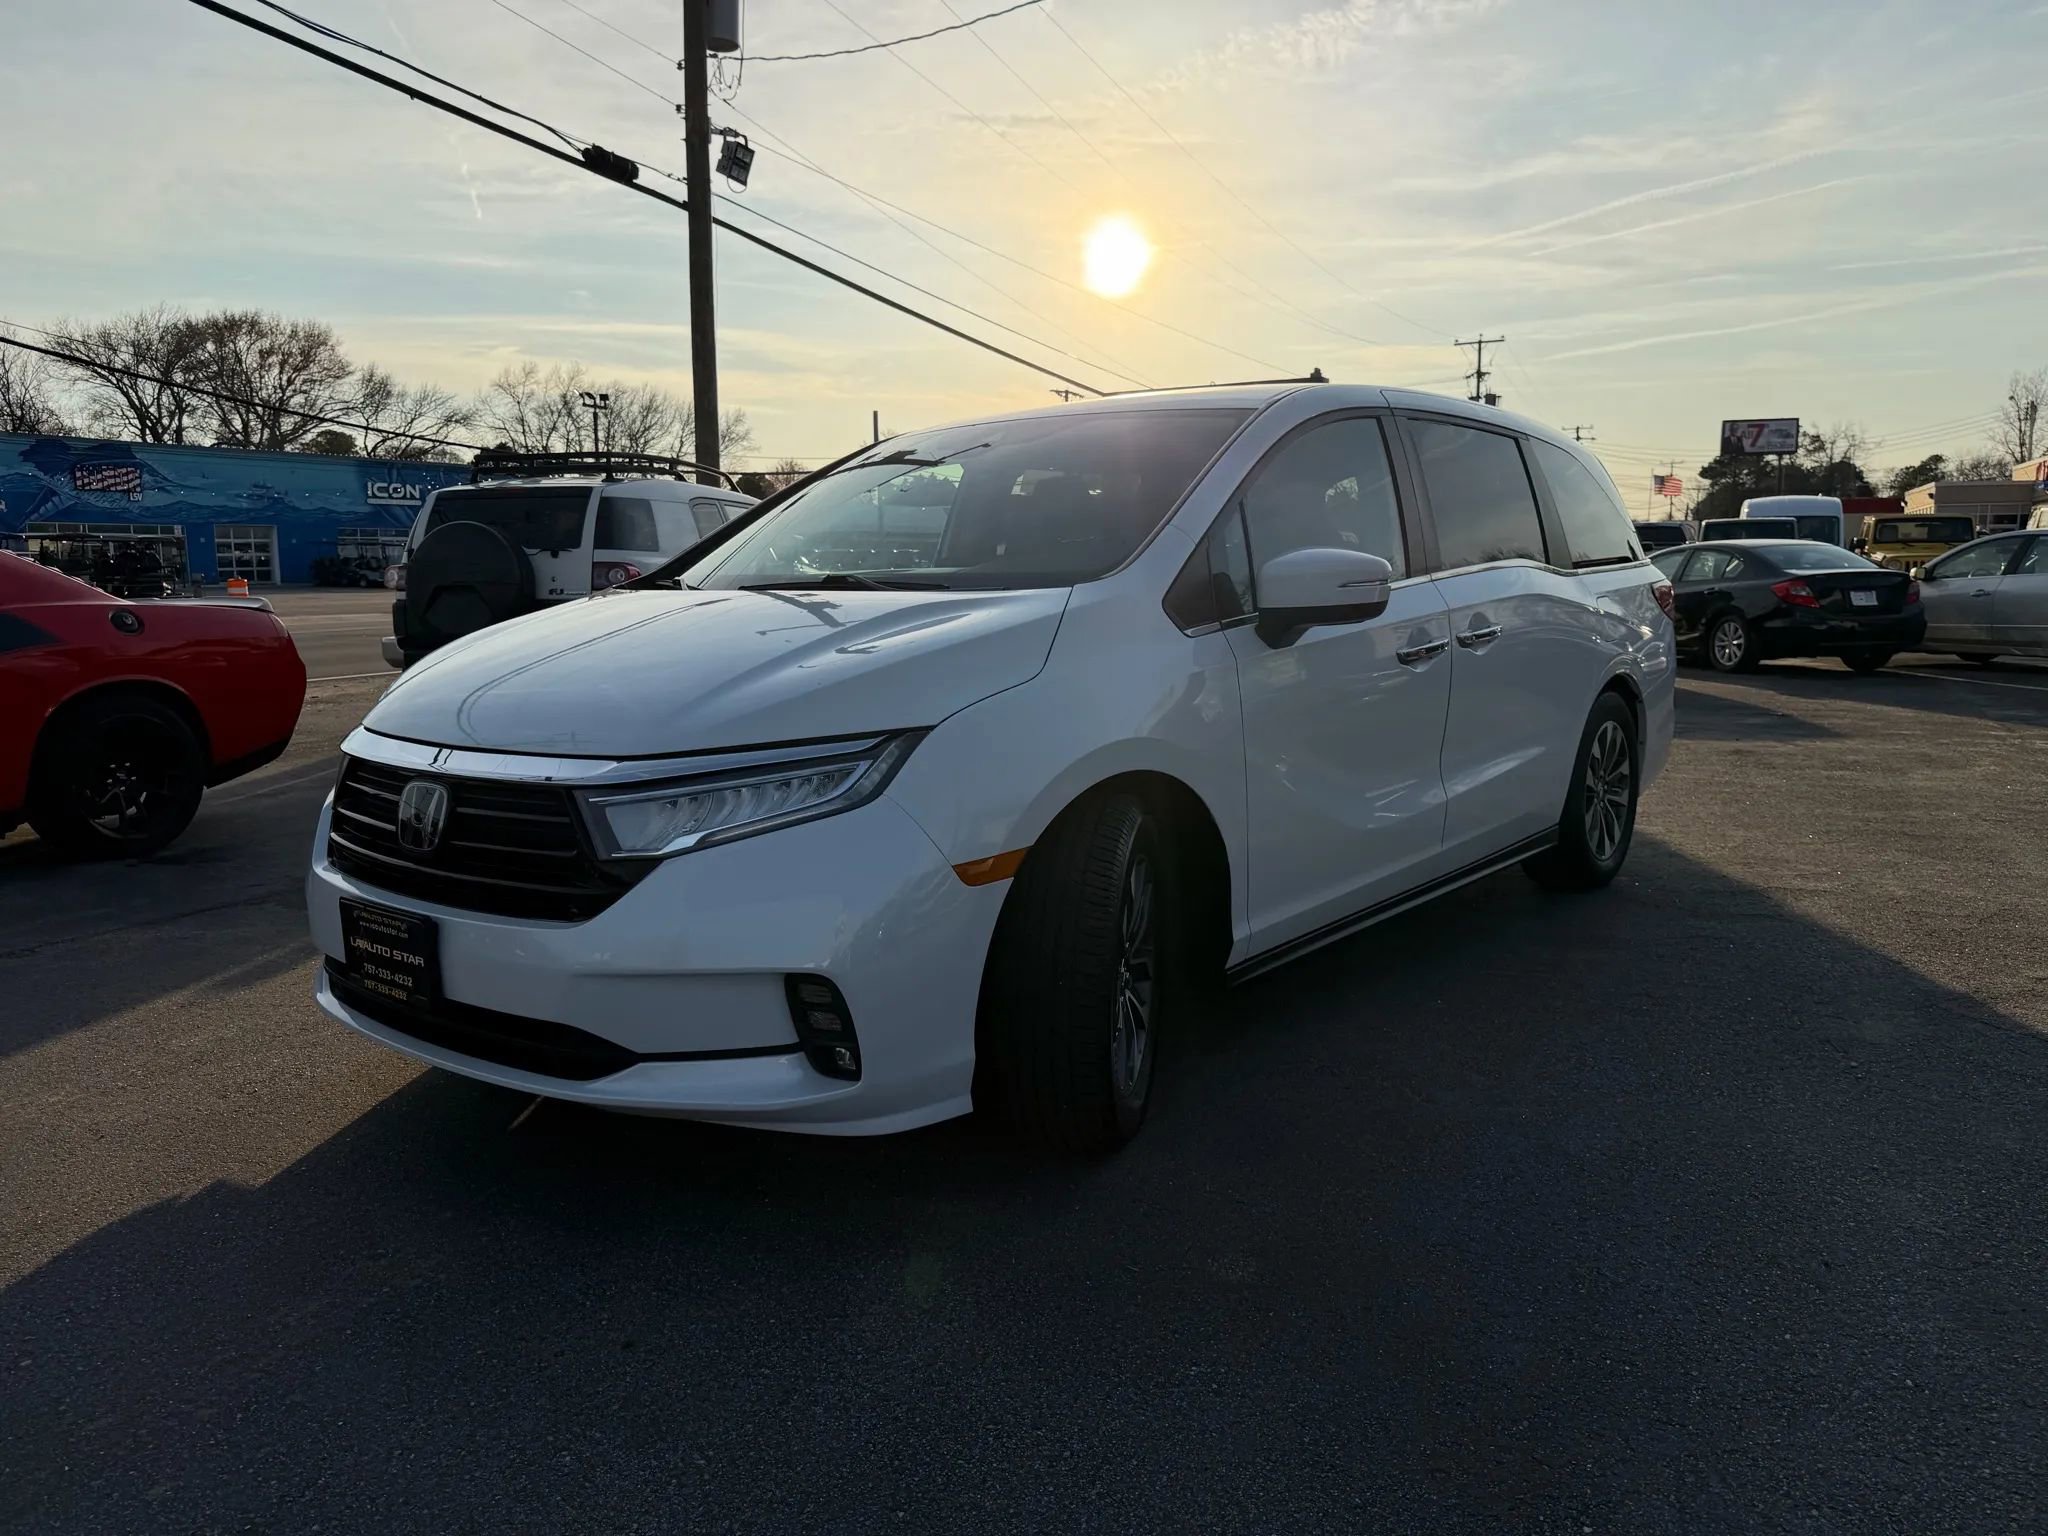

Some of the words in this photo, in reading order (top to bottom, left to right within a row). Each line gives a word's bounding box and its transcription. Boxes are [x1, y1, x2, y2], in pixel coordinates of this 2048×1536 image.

[130, 492, 142, 501] LSV
[367, 481, 420, 498] ICON
[393, 949, 425, 967] STAR
